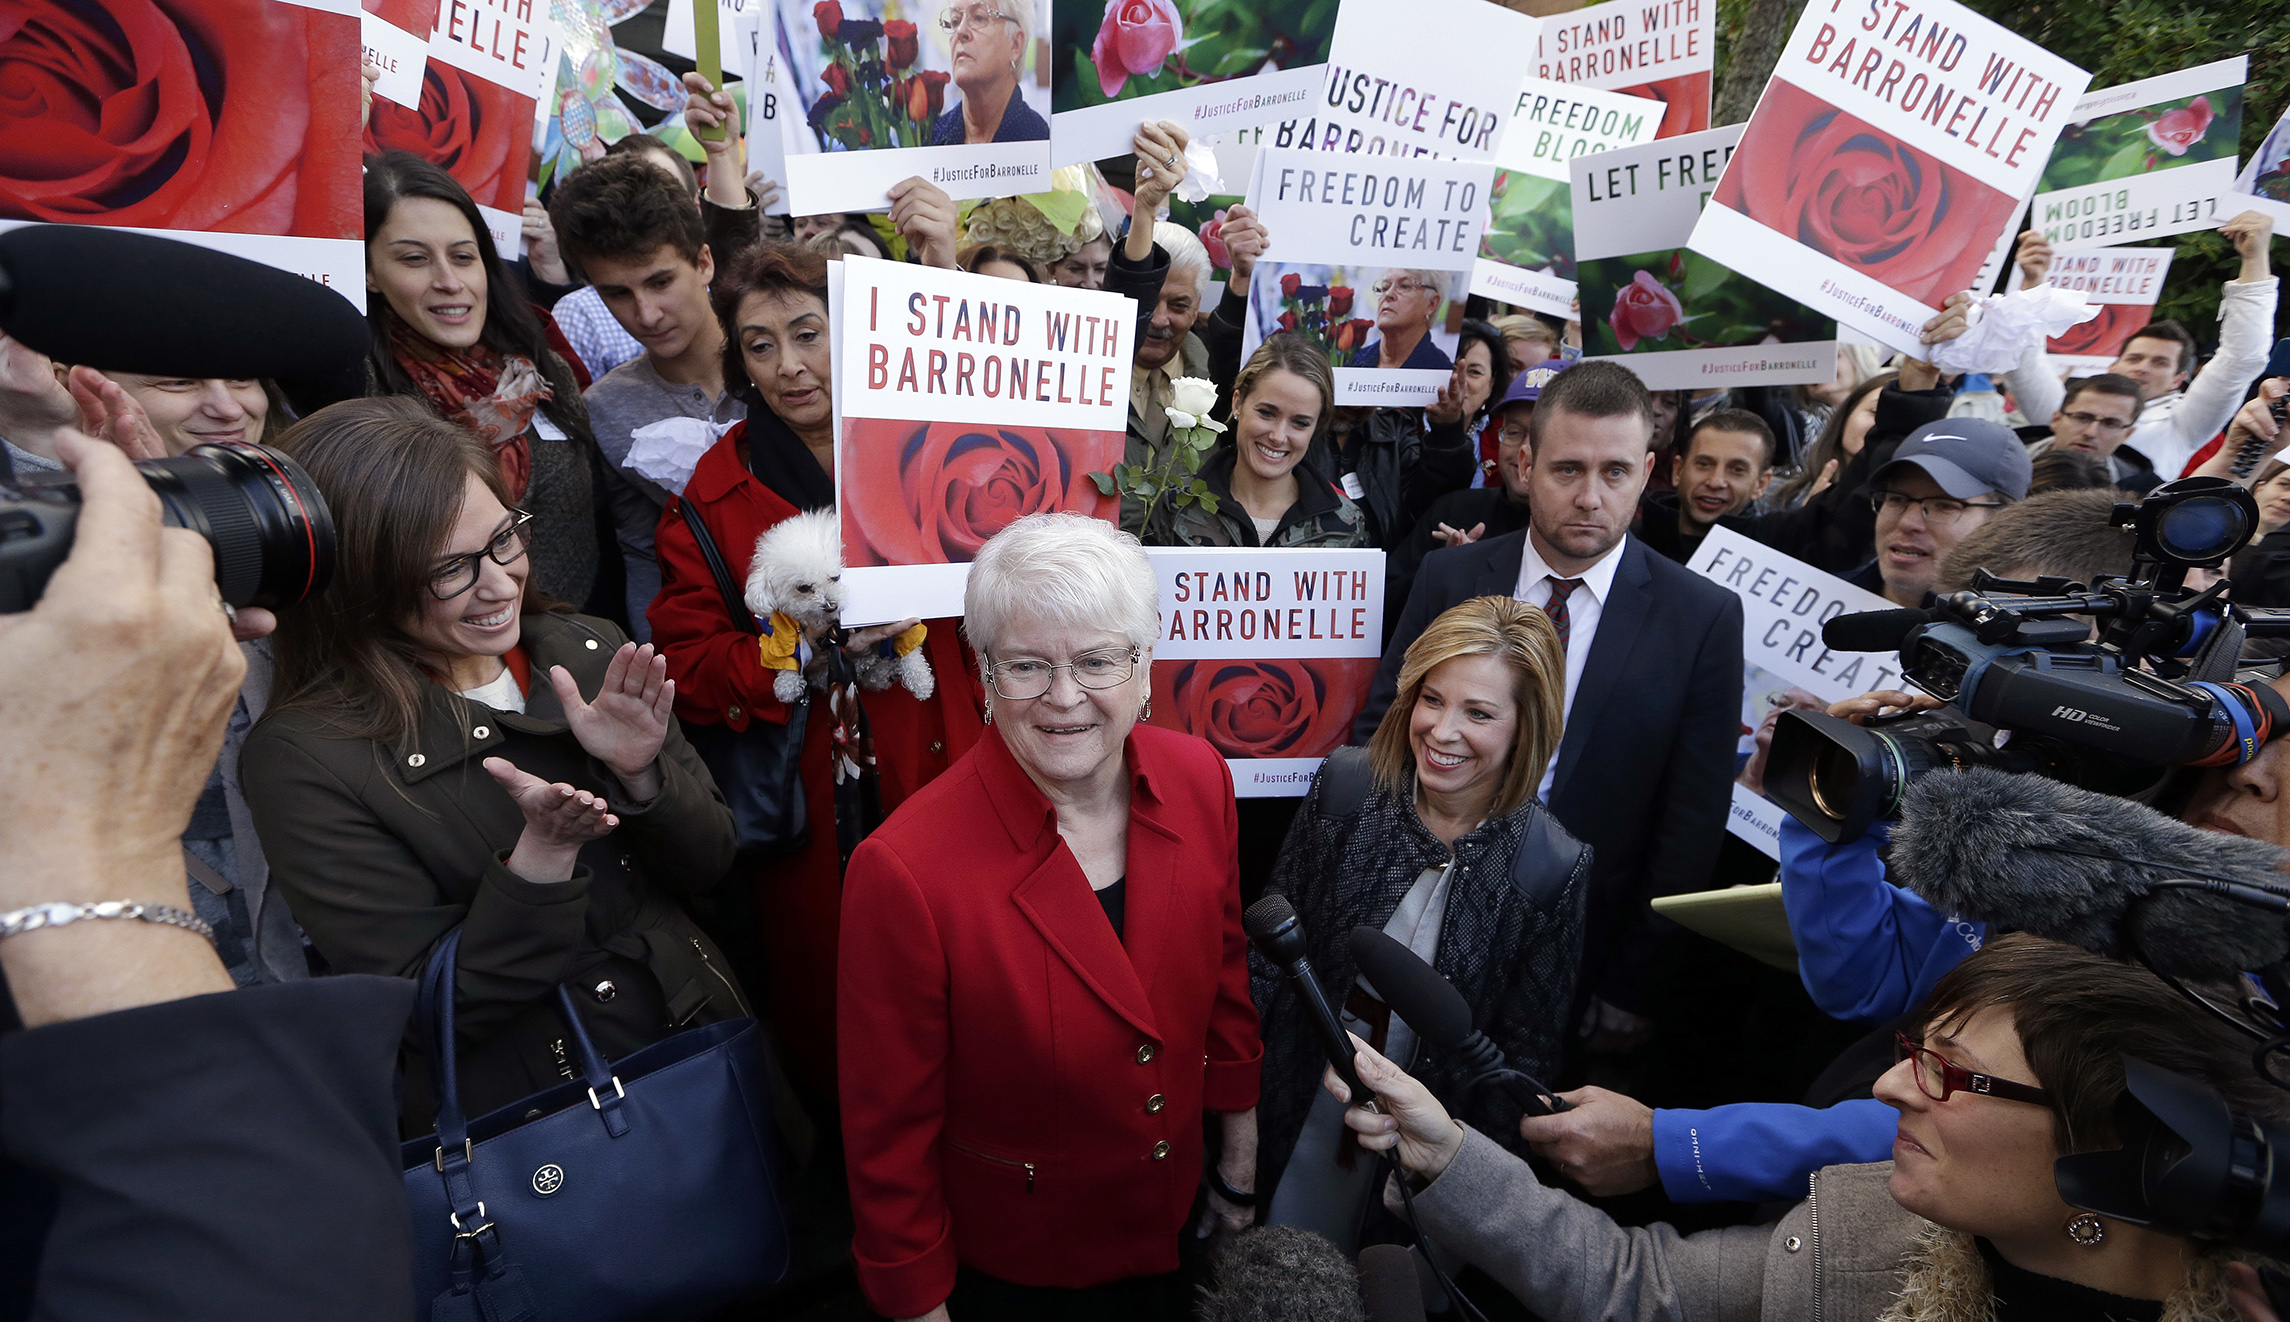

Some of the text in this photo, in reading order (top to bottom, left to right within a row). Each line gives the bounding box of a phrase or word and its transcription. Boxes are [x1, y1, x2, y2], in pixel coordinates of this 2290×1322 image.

[1539, 0, 1699, 58] I STAND WITH
[1539, 29, 1699, 83] BARRONELLE
[1861, 0, 2062, 122] STAND WITH
[1194, 89, 1307, 120] #JUSTICEFORBARRONELLE
[1325, 64, 1498, 151] USTICE FOR
[1806, 22, 2038, 168] BARRONELLE
[1513, 92, 1644, 142] FREEDOM
[934, 164, 1038, 182] #JUSTICEFORBARRONELLE
[1278, 168, 1476, 213] FREEDOM TO
[1588, 163, 1640, 202] LET
[2044, 197, 2217, 244] LET FREEDOM
[2045, 189, 2130, 223] BLOOM
[1350, 214, 1470, 252] CREATE
[2053, 257, 2160, 274] TAND WITH
[1487, 275, 1571, 305] #JUSTICEFORBARRONELL
[2047, 275, 2153, 295] RRONELLE
[870, 286, 1119, 357] I STAND WITH
[868, 343, 1116, 407] BARRONELLE
[1348, 380, 1436, 394] #JUSTICEFORBARRONELLE
[1174, 570, 1368, 602] STAND WITH
[1706, 548, 1847, 628] FREEDO
[1763, 619, 1907, 692] CREAT
[2051, 706, 2087, 722] HD
[2084, 719, 2120, 732] VIEWFINDER
[2088, 714, 2110, 723] COLOR
[1253, 772, 1315, 783] #JUSTICEFORB
